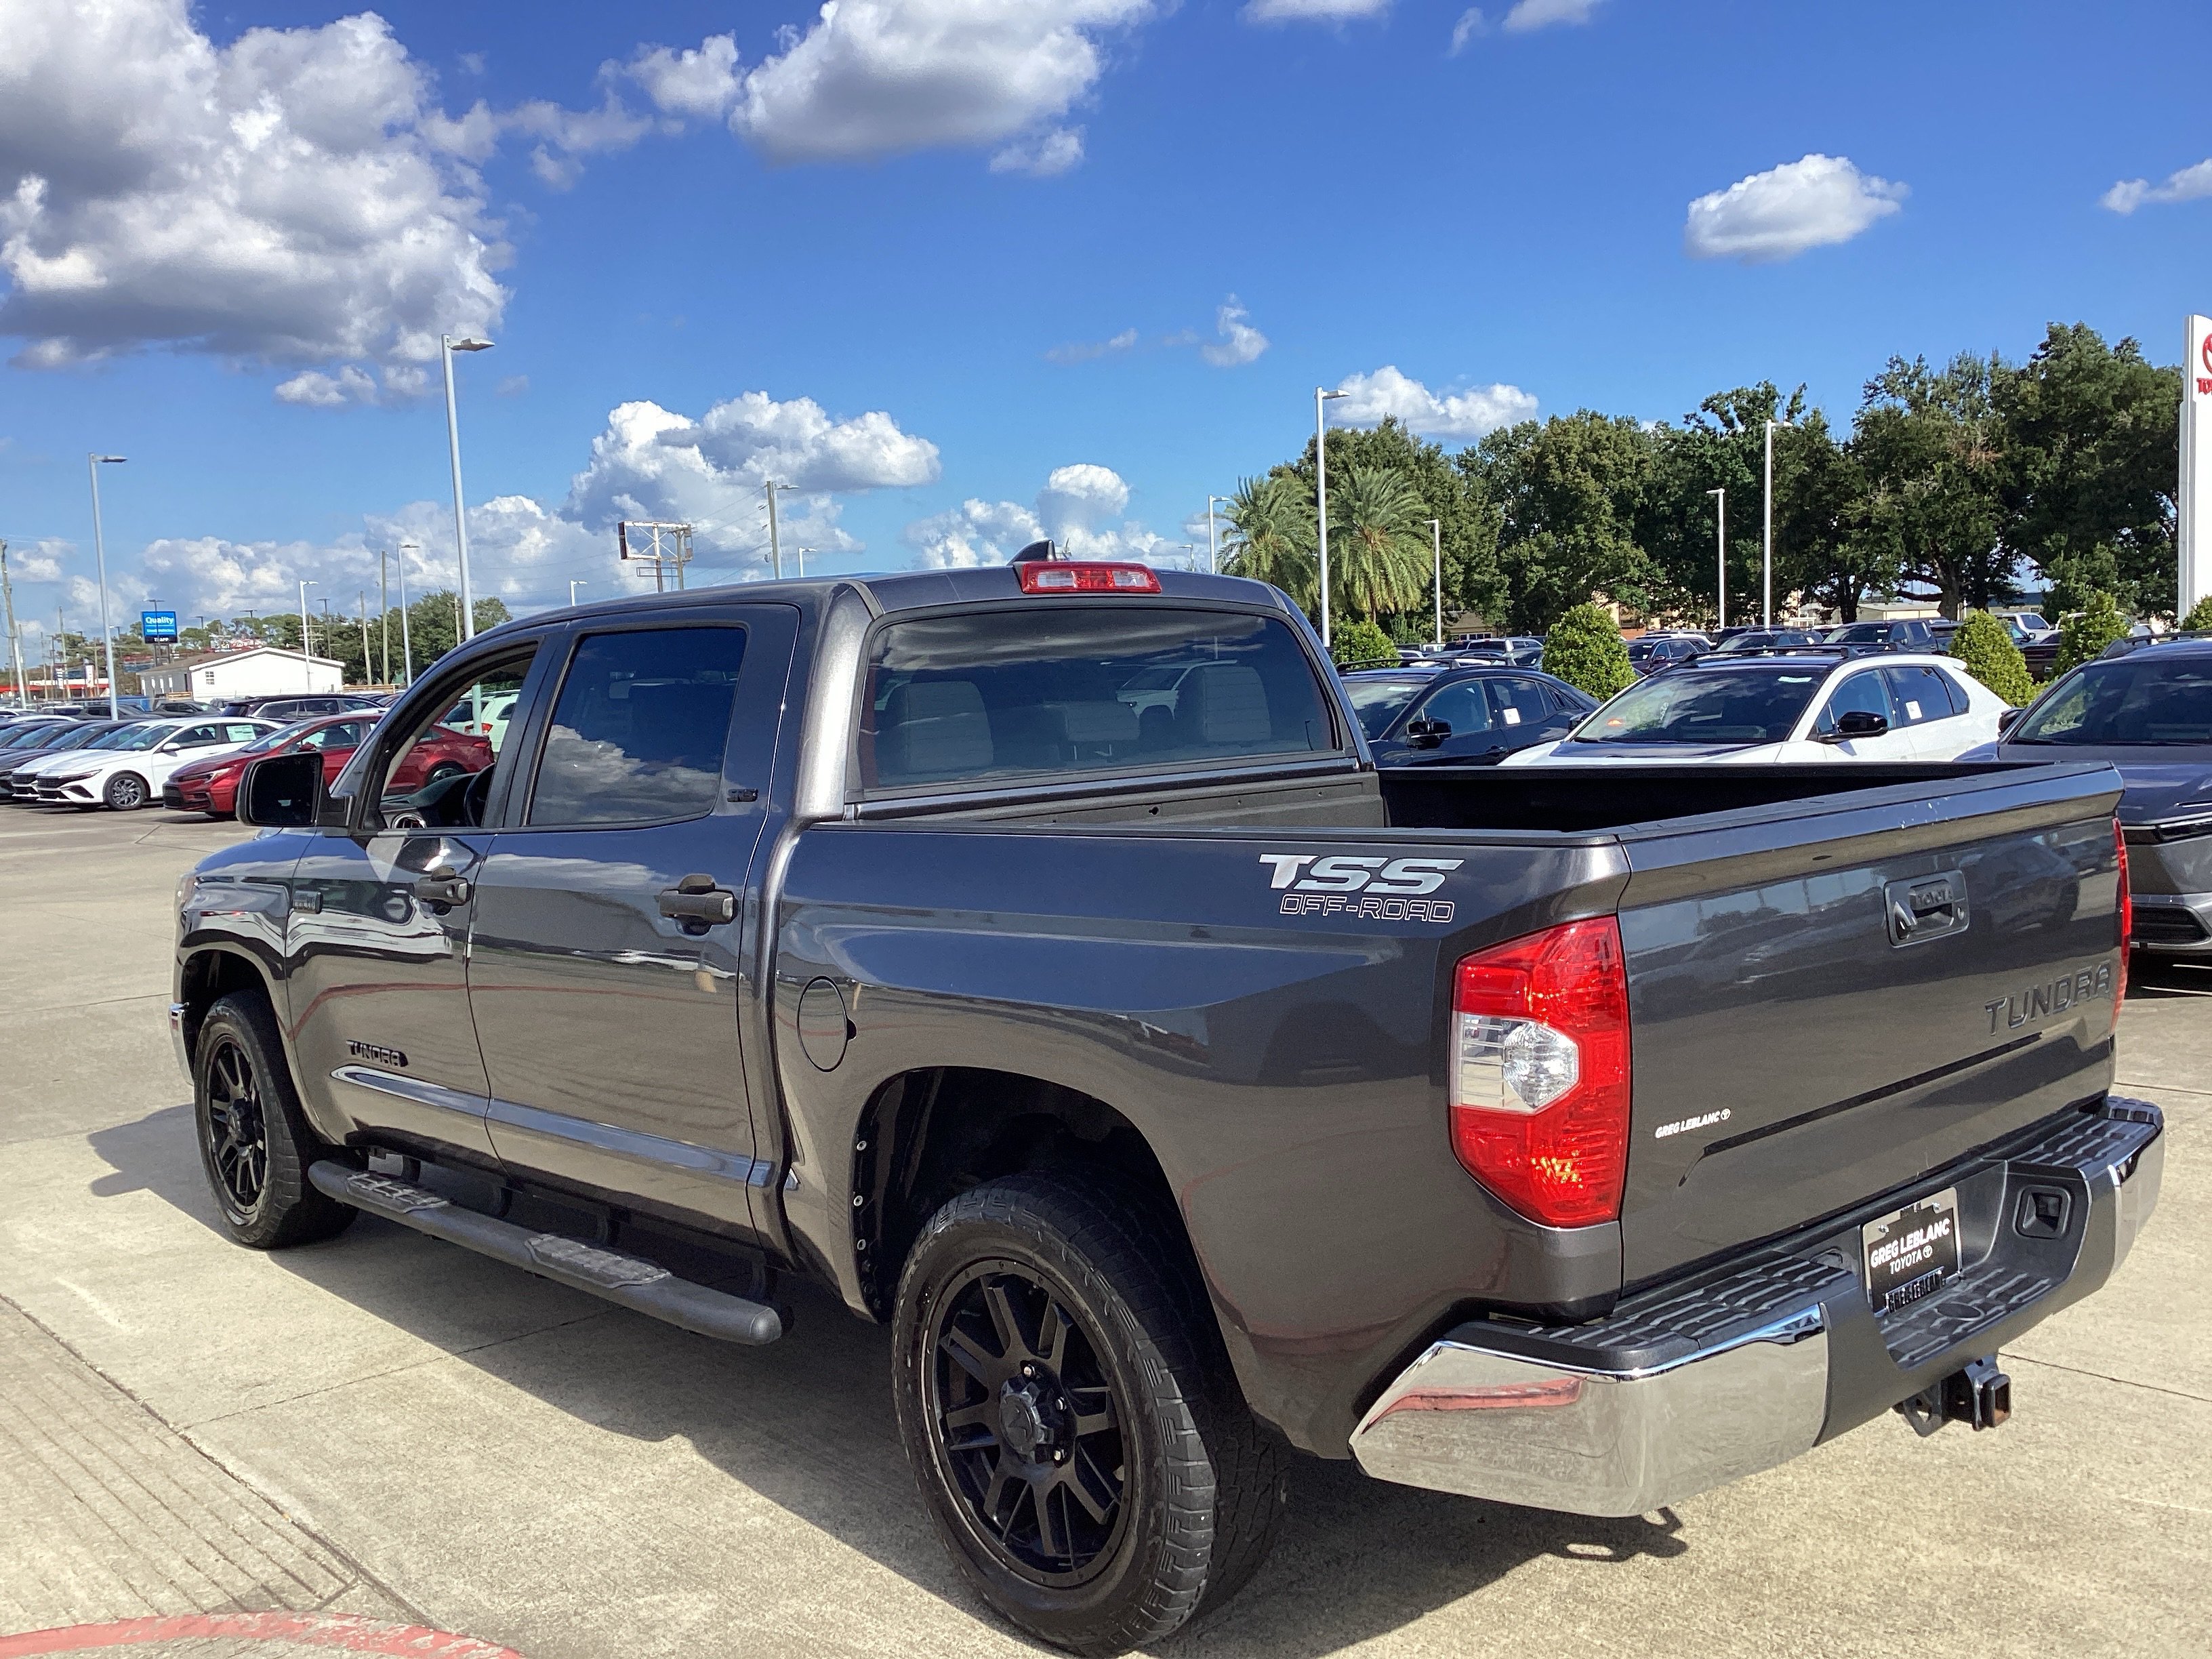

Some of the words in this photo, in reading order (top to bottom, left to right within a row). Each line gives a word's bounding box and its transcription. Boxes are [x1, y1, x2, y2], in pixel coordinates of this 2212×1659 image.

[145, 616, 174, 624] Quality
[1258, 854, 1465, 895] TSS
[1279, 893, 1456, 924] OFF-ROAD
[1984, 959, 2112, 1037] TUNDRA
[1654, 1121, 1681, 1139] GREG
[1680, 1110, 1721, 1132] LEBLANC
[1870, 1240, 1899, 1269] GREG
[1900, 1217, 1951, 1254] LEBLANC
[1889, 1248, 1923, 1275] TOYOTA
